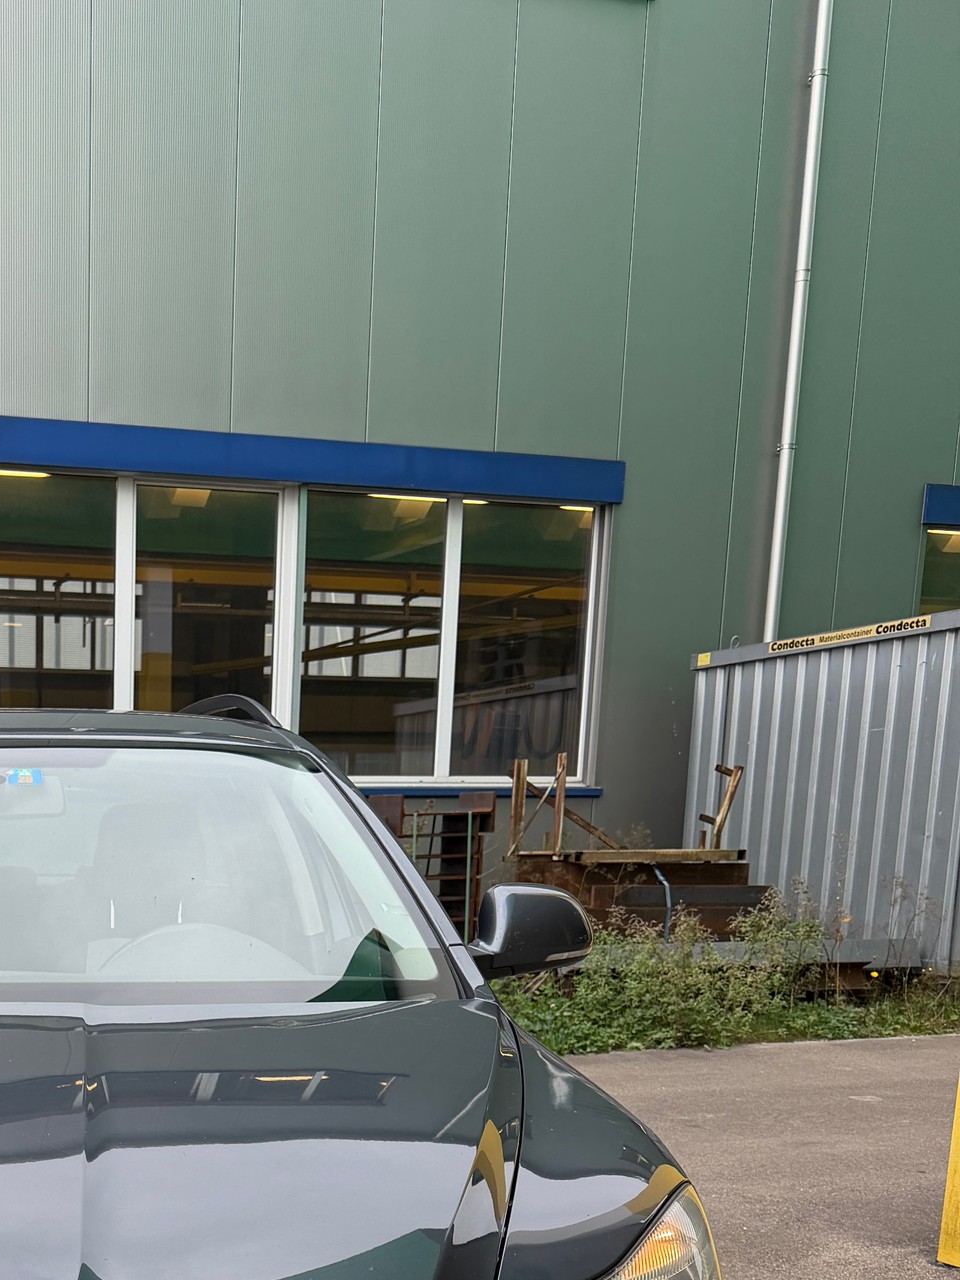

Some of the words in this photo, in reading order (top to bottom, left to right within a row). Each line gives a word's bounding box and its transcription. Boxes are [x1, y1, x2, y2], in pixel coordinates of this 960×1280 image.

[771, 637, 815, 651] Condecta
[819, 628, 872, 643] Materialcontainer
[875, 618, 927, 635] Condecta
